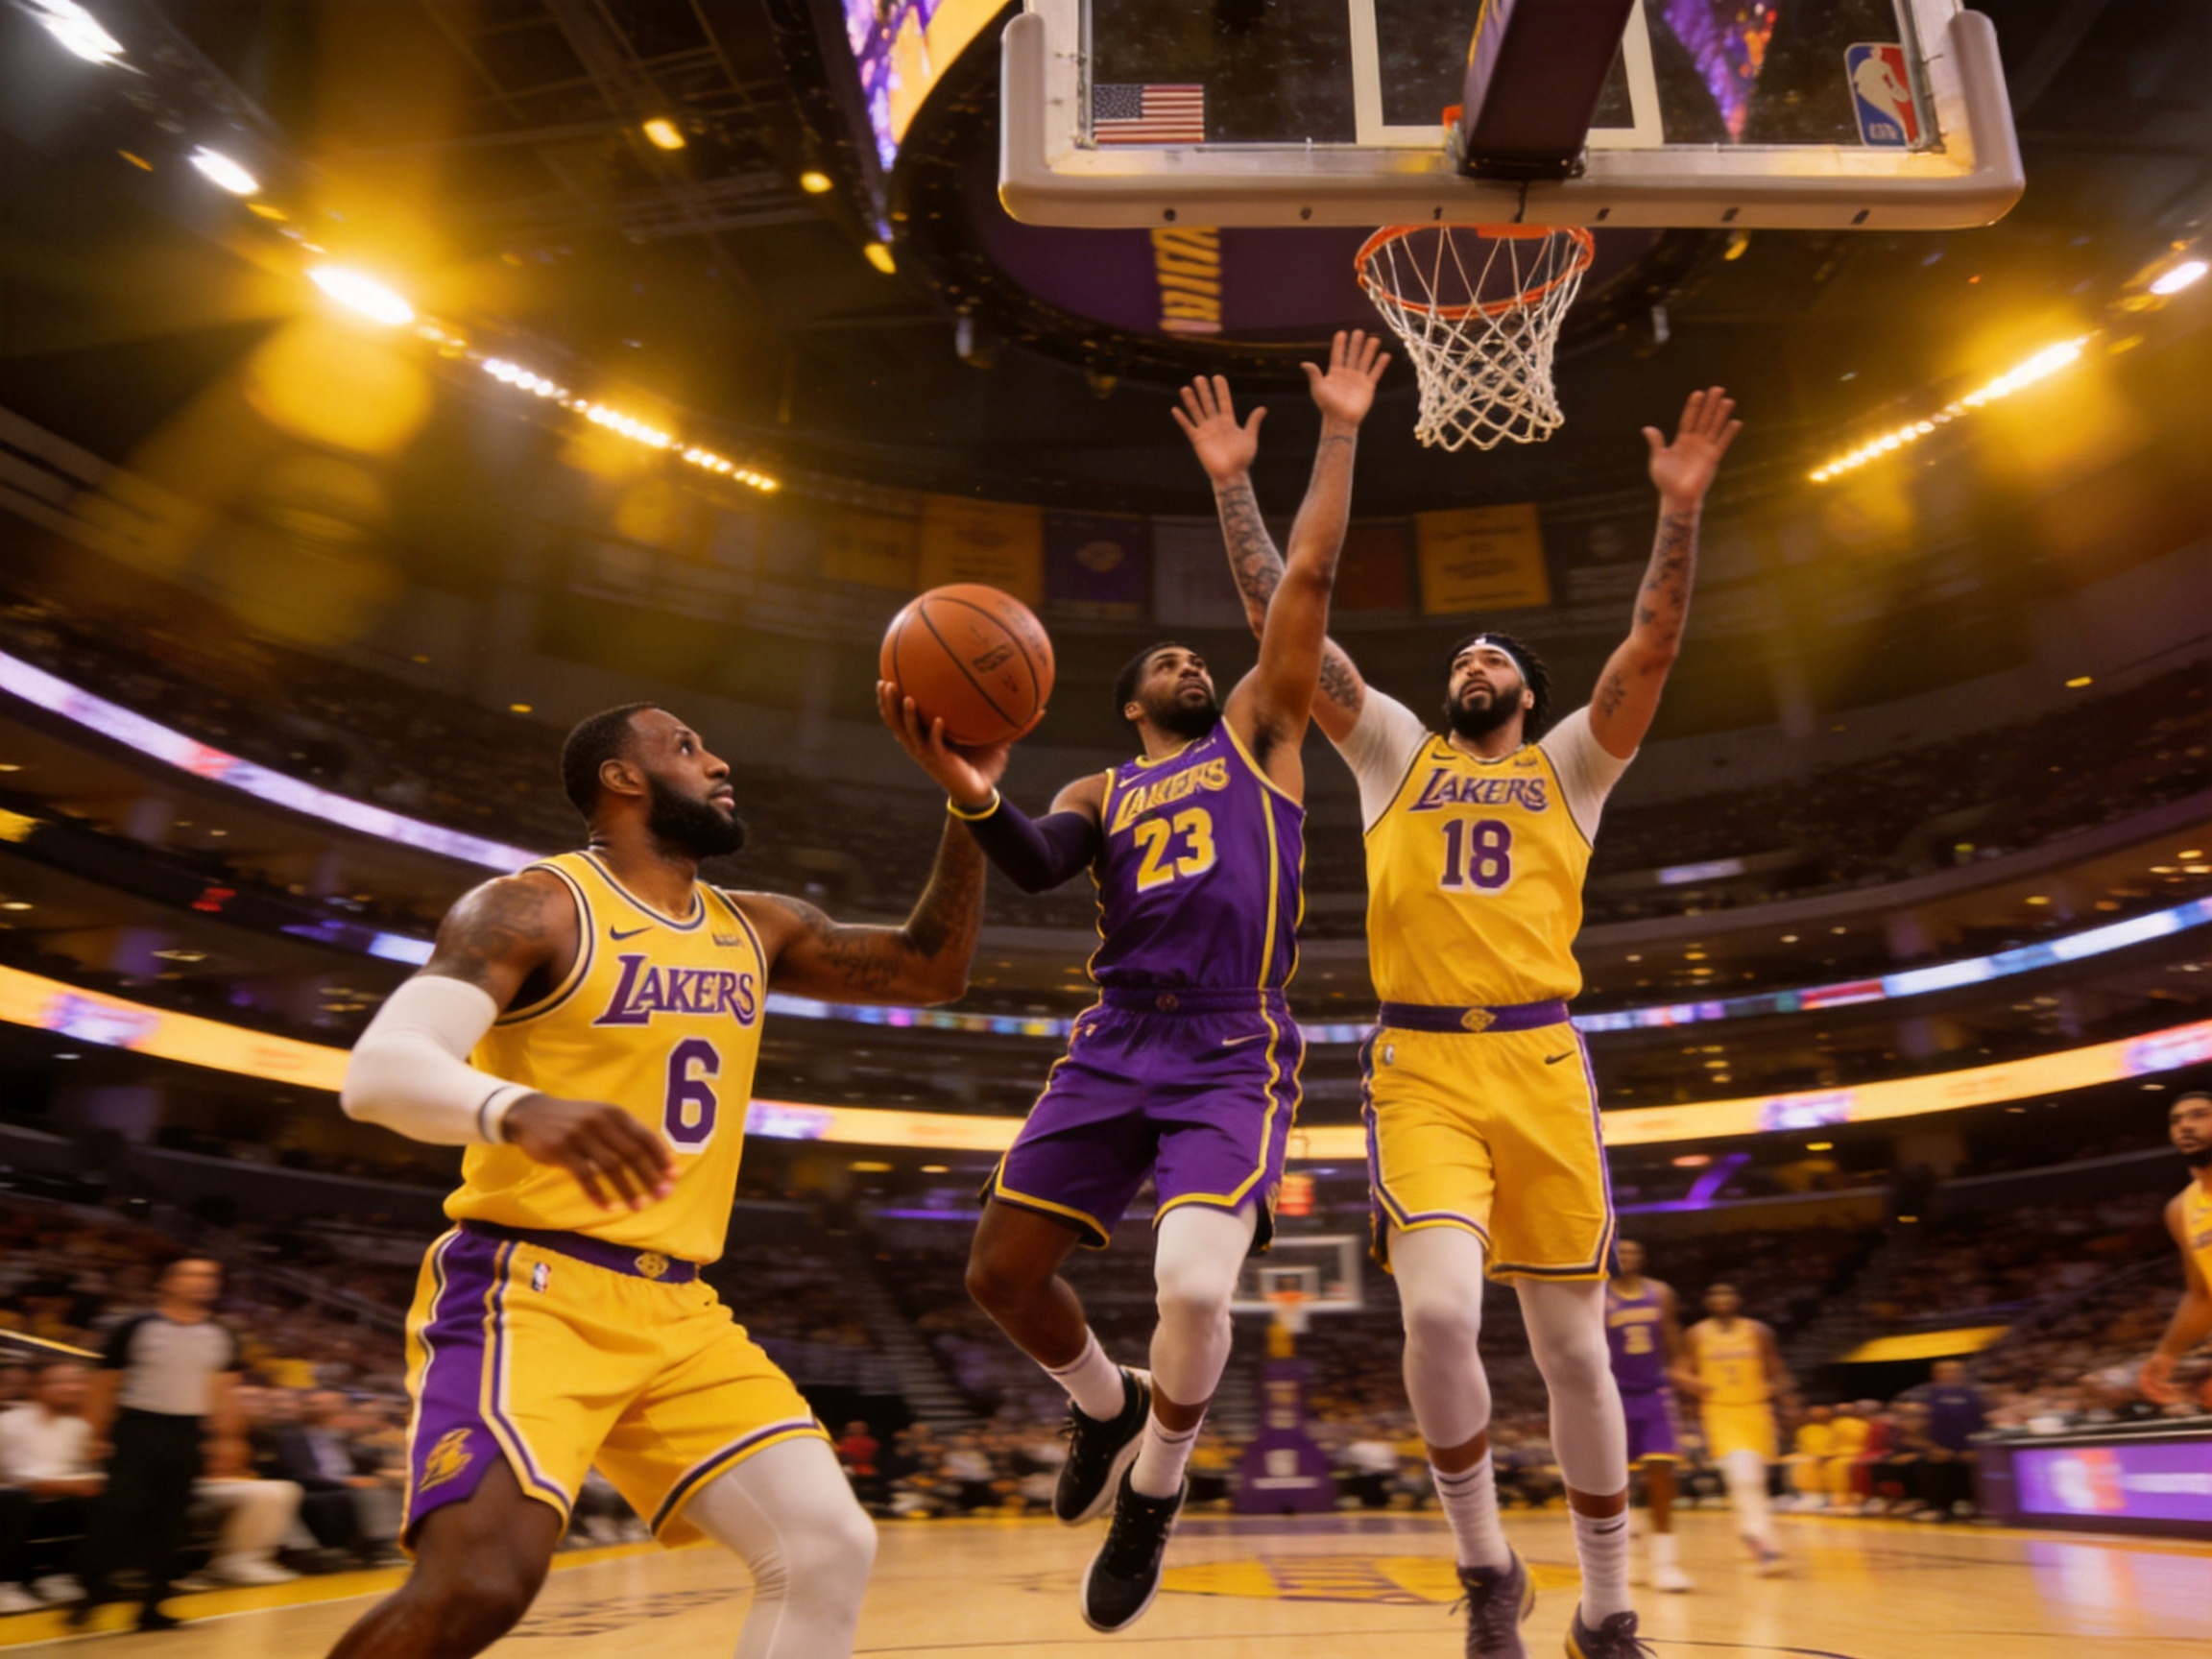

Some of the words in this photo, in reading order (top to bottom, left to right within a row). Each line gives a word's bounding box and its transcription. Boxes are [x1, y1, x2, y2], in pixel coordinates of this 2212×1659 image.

[1109, 757, 1231, 836] LAKERS
[1407, 767, 1550, 813] LAKERS
[1134, 806, 1217, 893] 23
[1440, 818, 1513, 894] 18
[591, 954, 756, 1026] LAKERS
[661, 1036, 721, 1154] 6
